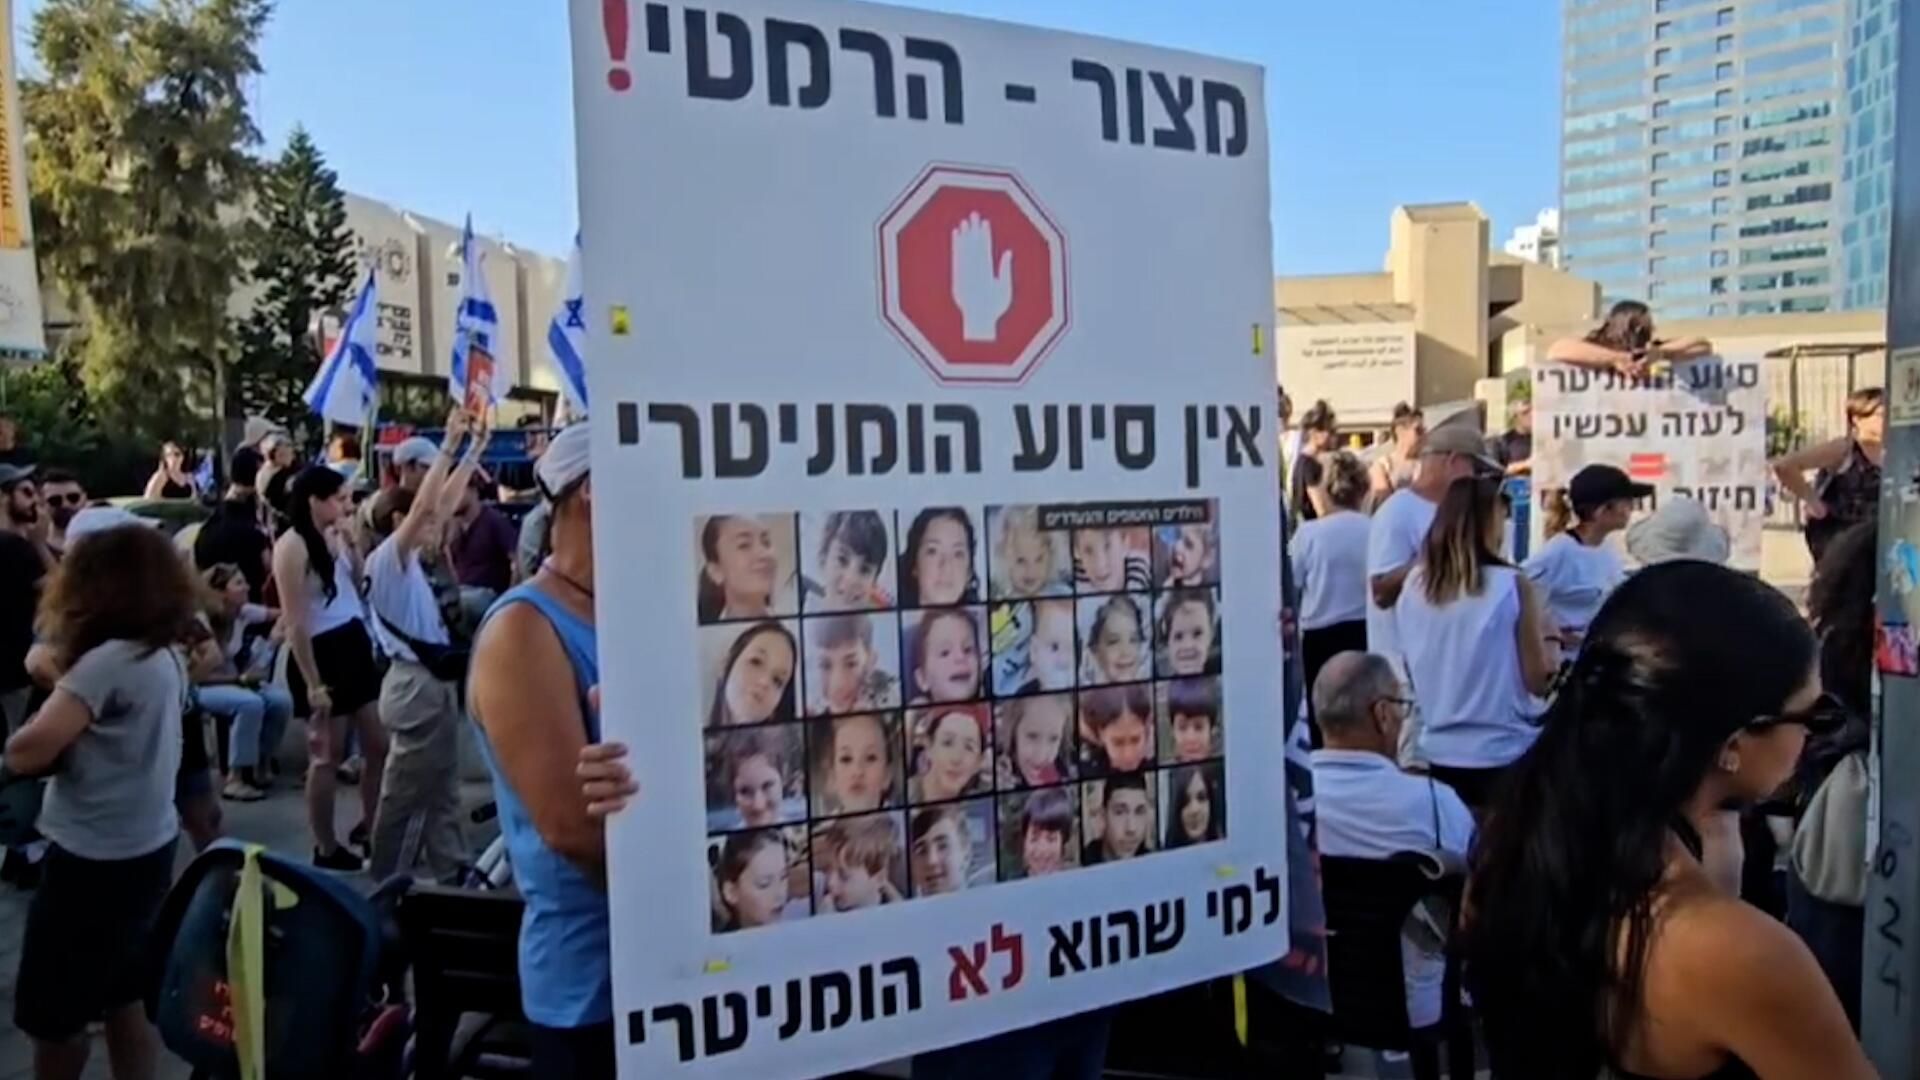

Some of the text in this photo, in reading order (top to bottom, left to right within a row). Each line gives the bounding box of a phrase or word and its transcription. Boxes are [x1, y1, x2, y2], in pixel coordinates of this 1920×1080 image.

[1071, 58, 1248, 157] מצור
[1687, 363, 1759, 390] סיוע
[618, 402, 1264, 489] אין סיוע הומניטרי
[1552, 406, 1745, 439] לעזה עכשיו
[628, 866, 1281, 1063] למי שהוא לא הומניטרי
